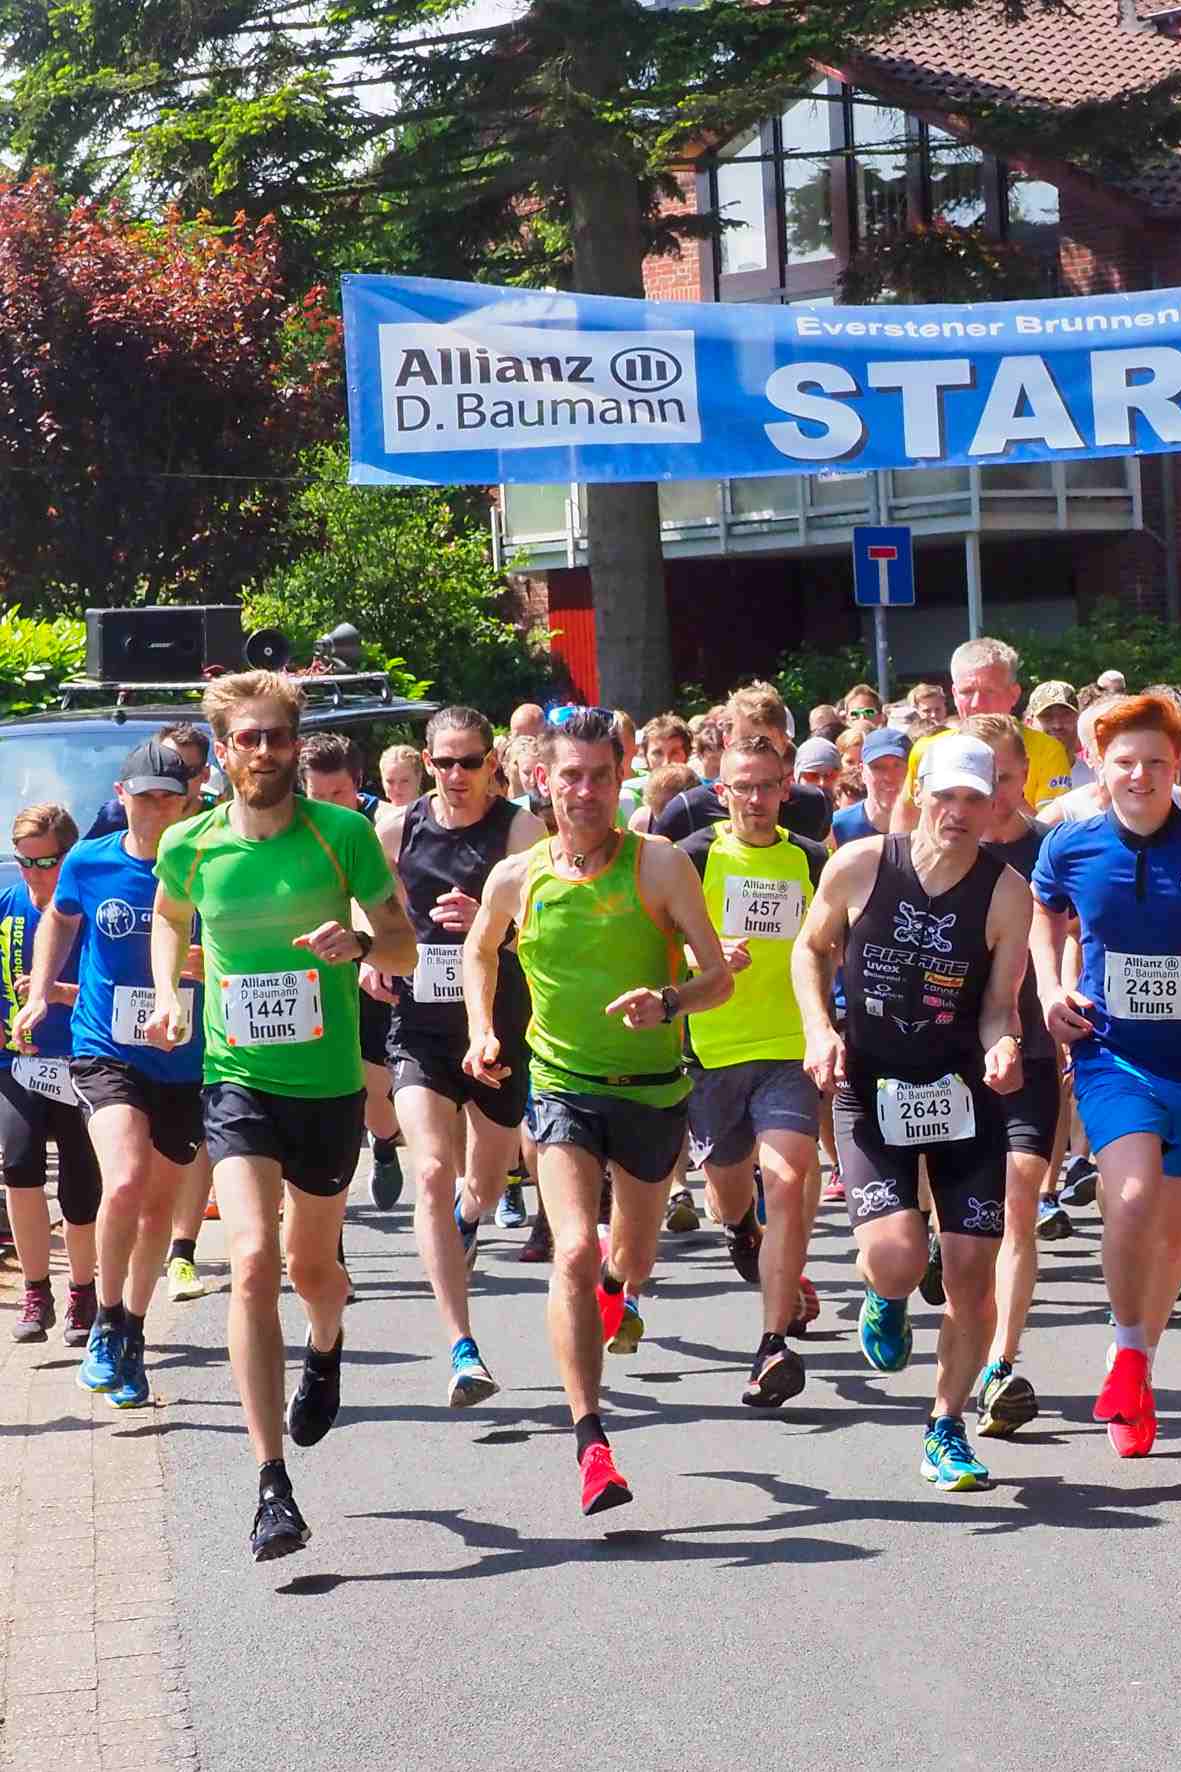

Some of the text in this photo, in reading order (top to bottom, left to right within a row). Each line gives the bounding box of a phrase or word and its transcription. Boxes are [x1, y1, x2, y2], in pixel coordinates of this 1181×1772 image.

[796, 316, 1005, 338] Everstener
[395, 347, 595, 387] Allianz
[396, 392, 686, 432] D. Baumann
[743, 879, 776, 891] Allianz
[748, 900, 781, 917] 457
[744, 916, 782, 933] bruns
[427, 947, 457, 956] Allianz
[867, 960, 900, 974] uvex
[1124, 957, 1163, 968] Allianz
[241, 976, 280, 988] Allianz
[1136, 969, 1179, 978] Baumann
[253, 988, 298, 999] Baumann
[433, 984, 464, 997] brun
[1125, 979, 1177, 996] 2438
[244, 998, 297, 1019] 1447
[1129, 996, 1173, 1014] bruns
[250, 1020, 296, 1039] bruns
[39, 1065, 58, 1080] 25
[28, 1076, 62, 1096] bruns
[908, 1088, 952, 1100] Baumann
[899, 1098, 951, 1120] 2643
[905, 1121, 949, 1139] bruns
